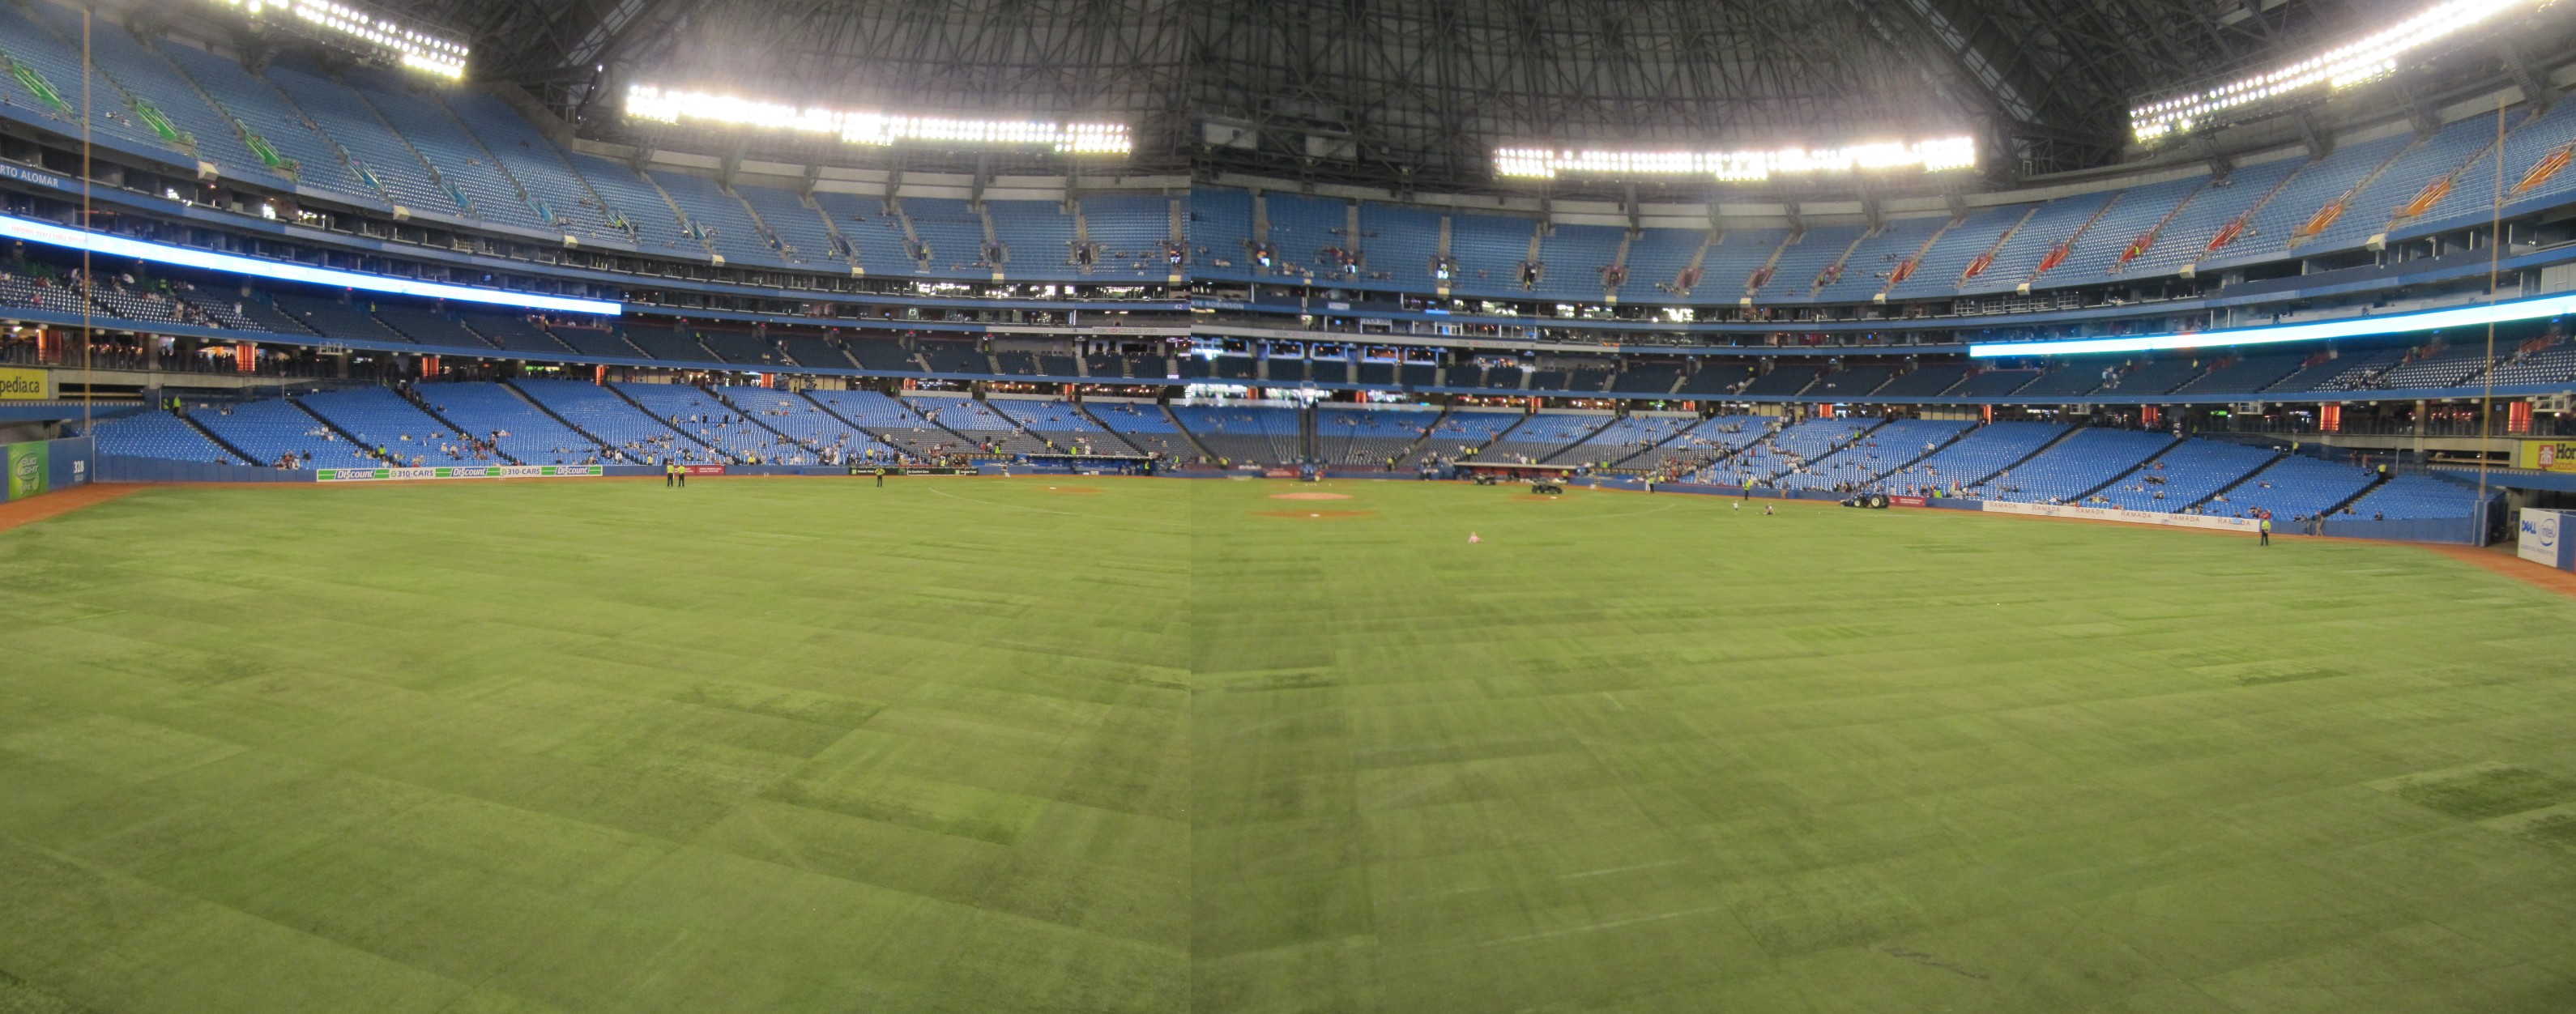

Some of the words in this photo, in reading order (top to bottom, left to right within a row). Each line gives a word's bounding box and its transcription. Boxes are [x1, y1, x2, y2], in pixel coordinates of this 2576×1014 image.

[0, 164, 18, 177] RTO
[21, 170, 58, 187] ALOMAR
[1206, 300, 1244, 309] ROBINSON
[0, 376, 40, 397] pedia.ca
[74, 460, 84, 474] 328
[452, 467, 486, 476] Discount
[557, 467, 588, 475] Discount
[337, 470, 373, 479] Discount
[2218, 518, 2250, 526] RADA
[2522, 520, 2536, 535] DELL
[2541, 524, 2556, 539] intel
